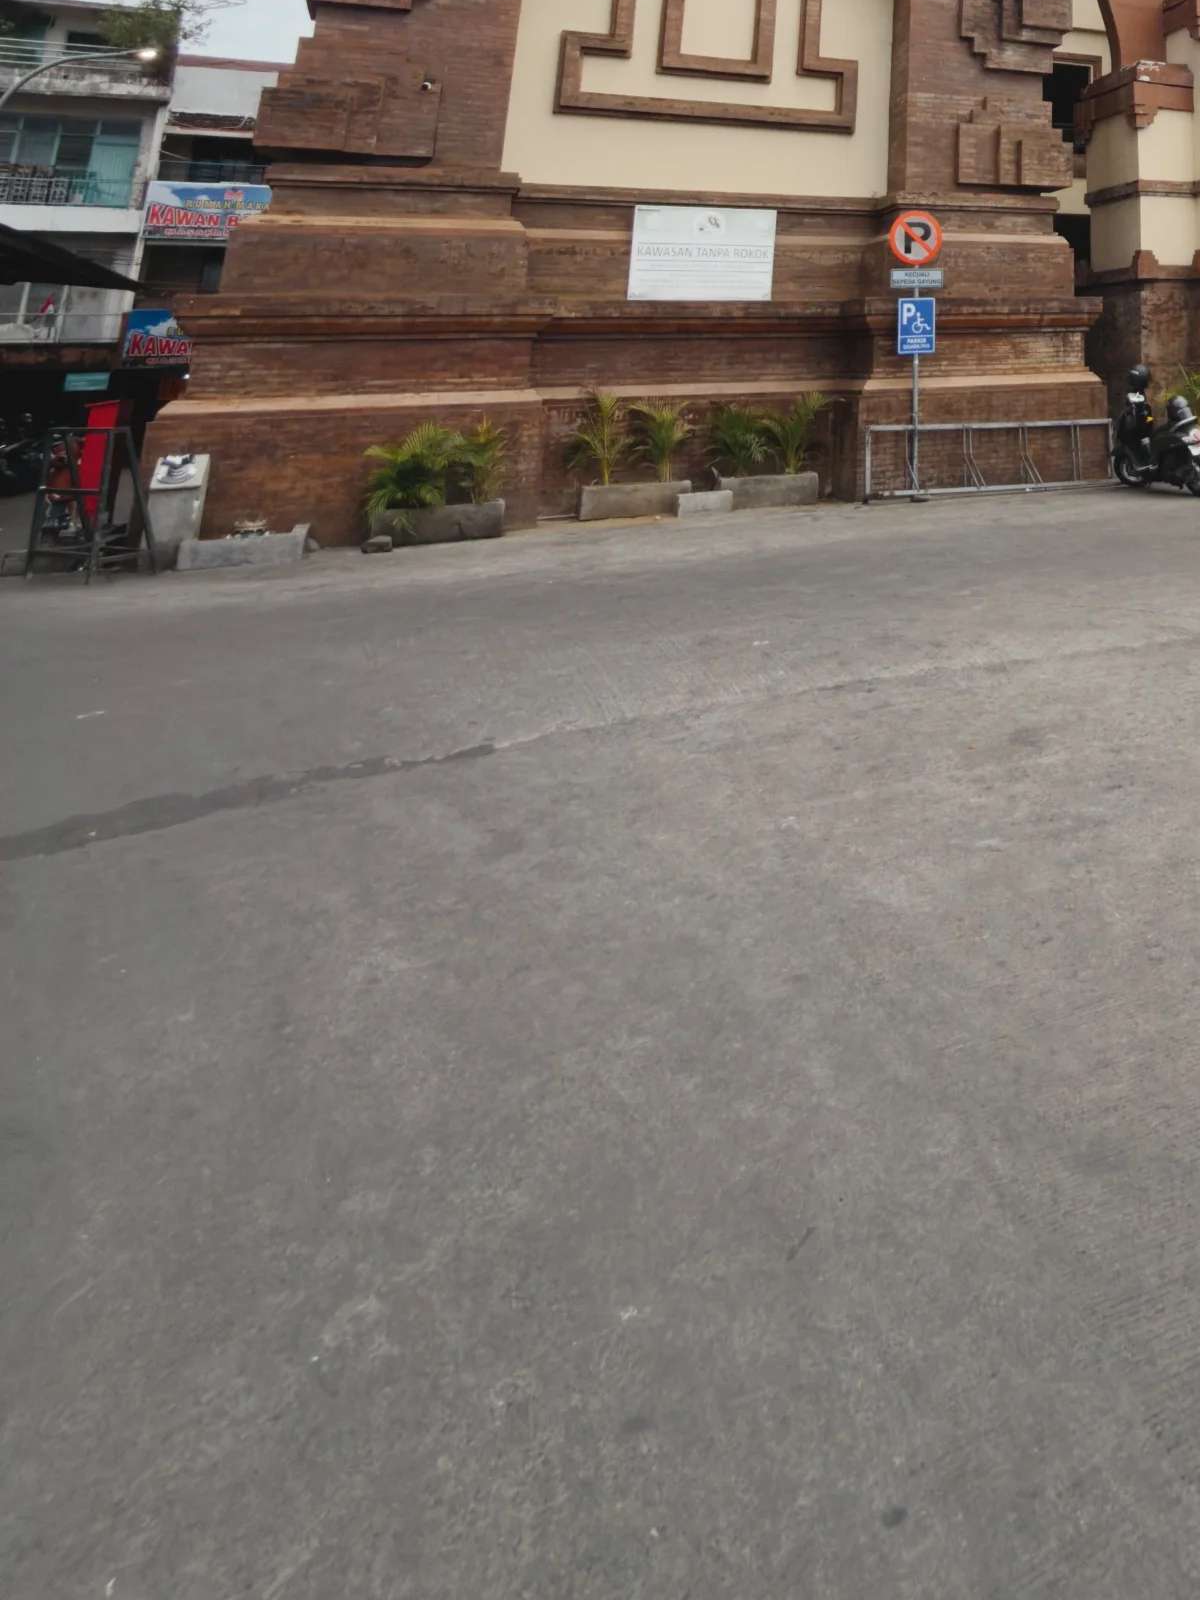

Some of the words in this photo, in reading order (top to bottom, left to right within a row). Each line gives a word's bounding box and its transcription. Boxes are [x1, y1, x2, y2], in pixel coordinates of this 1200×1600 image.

[148, 203, 220, 227] KAWAN
[185, 200, 231, 210] RUMAH
[236, 202, 271, 211] MAKA
[637, 245, 693, 257] KAWASAN
[696, 247, 730, 258] TANPA
[733, 248, 769, 259] ROKOK
[902, 303, 916, 325] P
[129, 331, 192, 356] KAWA
